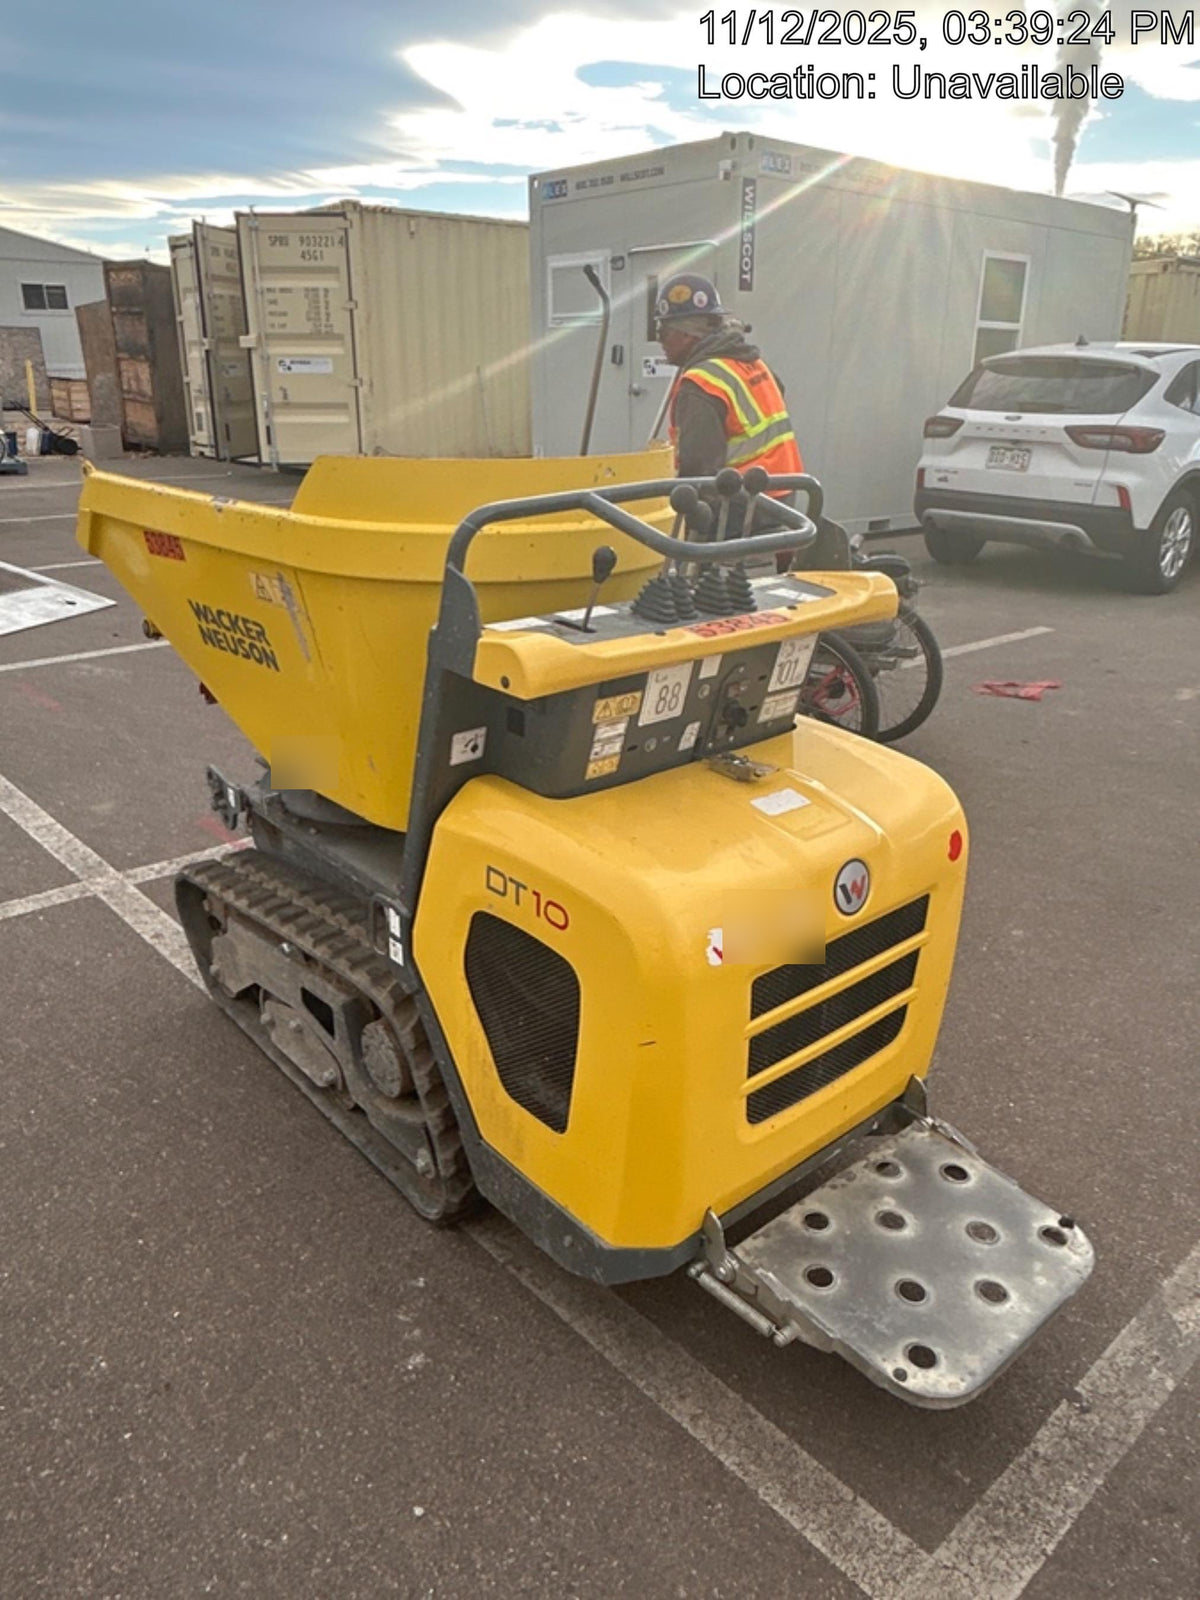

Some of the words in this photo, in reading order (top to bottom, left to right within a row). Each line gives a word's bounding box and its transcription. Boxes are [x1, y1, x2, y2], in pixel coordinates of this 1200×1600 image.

[187, 598, 272, 647] WACKER
[198, 623, 281, 673] NEUSON
[655, 681, 682, 716] 88
